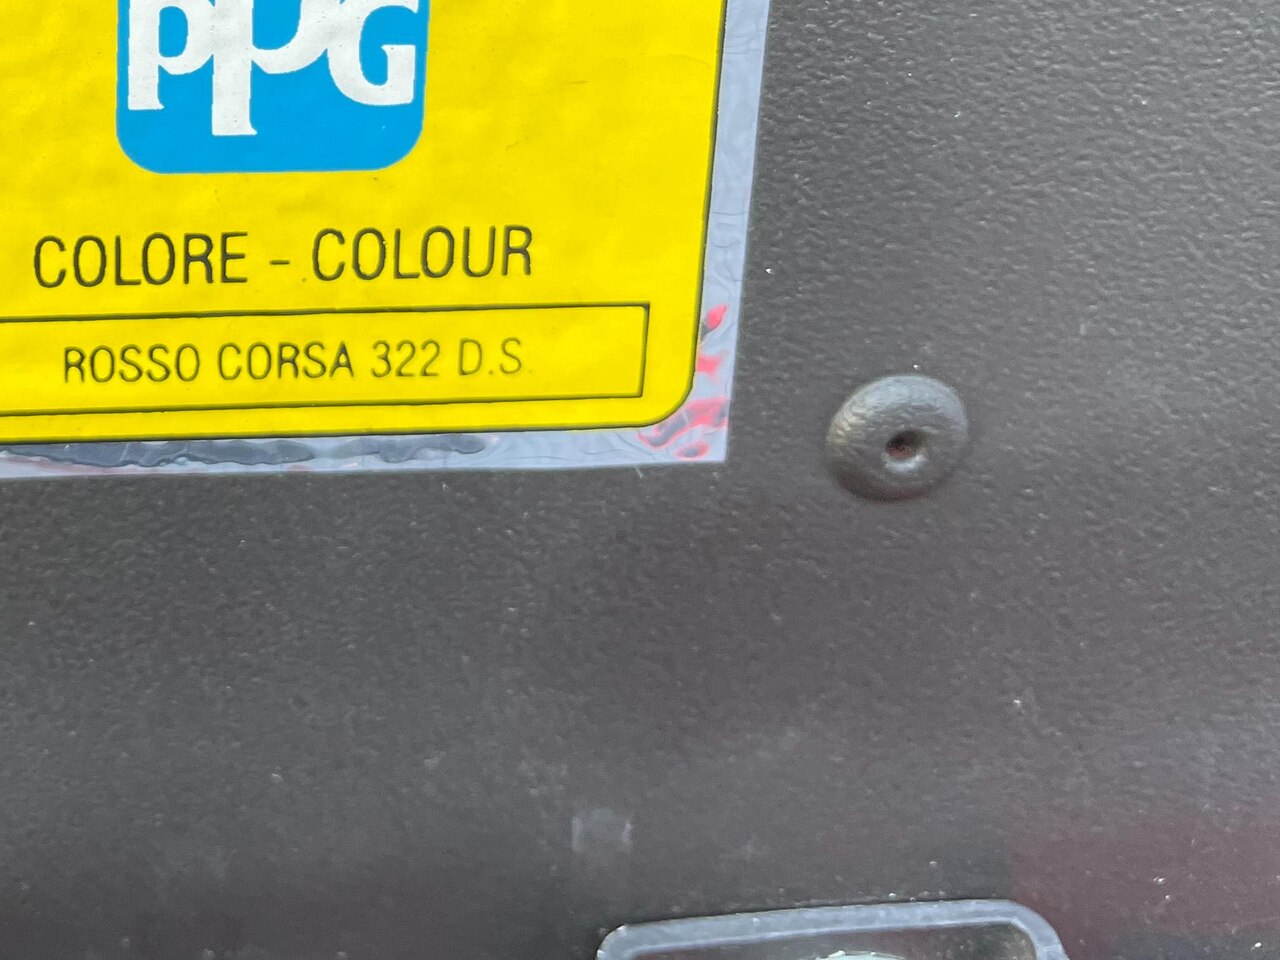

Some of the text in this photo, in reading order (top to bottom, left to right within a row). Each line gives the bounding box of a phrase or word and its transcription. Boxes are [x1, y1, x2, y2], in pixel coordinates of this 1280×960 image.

[33, 231, 248, 288] COLORE
[311, 225, 532, 281] COLOUR
[64, 344, 200, 384] ROSSO
[218, 341, 355, 381] CORSA
[371, 339, 441, 378] 322
